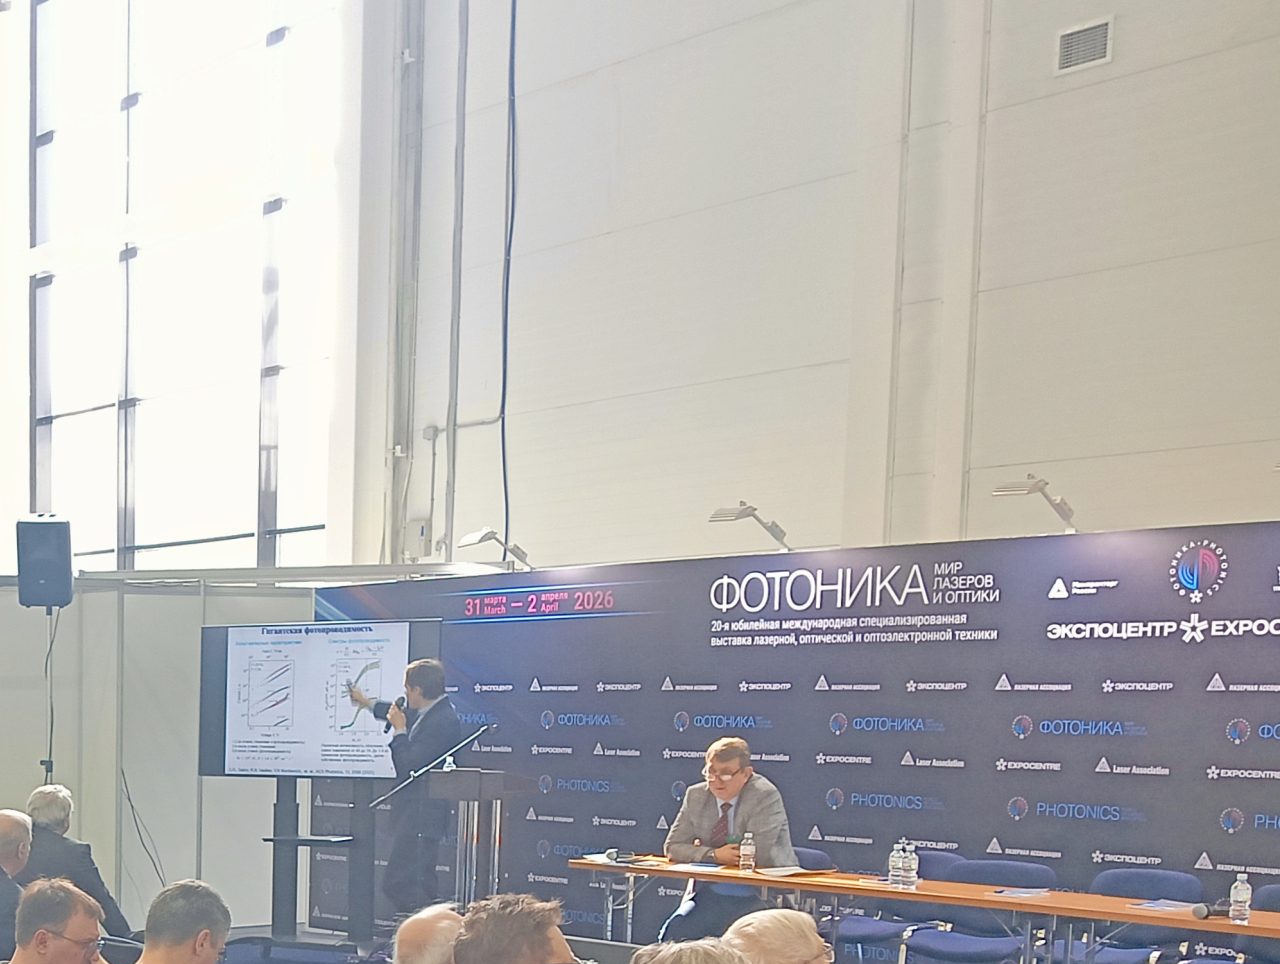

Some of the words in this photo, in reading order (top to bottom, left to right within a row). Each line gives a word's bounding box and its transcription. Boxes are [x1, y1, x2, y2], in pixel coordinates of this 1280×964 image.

[933, 561, 963, 576] МИР
[1202, 539, 1229, 597] PHOTONICS
[710, 563, 930, 613] ФОТОНИКА
[933, 575, 995, 590] ЛАЗЕРОВ
[464, 599, 481, 616] 31
[527, 594, 537, 613] 2
[574, 590, 614, 611] 2026
[933, 591, 942, 604] И
[945, 589, 1000, 604] ОПТИКИ
[484, 606, 506, 615] March
[540, 603, 559, 614] April
[711, 619, 730, 632] 20-я
[731, 618, 780, 631] юбилейная
[782, 615, 857, 632] международная
[859, 613, 967, 629] специализированная
[710, 635, 752, 647] выставка
[753, 633, 798, 648] лазерной,
[799, 632, 854, 646] оптической
[856, 633, 863, 643] и
[863, 629, 952, 645] оптоэлектронной
[955, 628, 998, 641] техники
[1046, 621, 1178, 640] ЭКСПОЦЕНТР
[748, 682, 792, 691] ЭКСПОЦЕНТР
[917, 682, 968, 692] ЭКСПОЦЕНТР
[1114, 682, 1173, 692] ЭКСПОЦЕНТР
[557, 714, 611, 726] ФОТОНИКА
[693, 715, 756, 729] ФОТОНИКА
[852, 717, 925, 732] ФОТОНИКА
[1038, 719, 1124, 736] ФОТОНИКА
[671, 750, 707, 759] EXPOCENT
[825, 755, 872, 764] EXPOCENTRE
[1007, 761, 1061, 771] EXPOCENTRE
[1113, 765, 1130, 775] Laser
[1131, 765, 1170, 776] Association
[556, 778, 610, 793] PHOTONICS
[850, 792, 923, 809] PHOTONICS
[1036, 802, 1121, 821] PHOTONICS
[1104, 855, 1162, 865] ЭКСПОЦЕНТР
